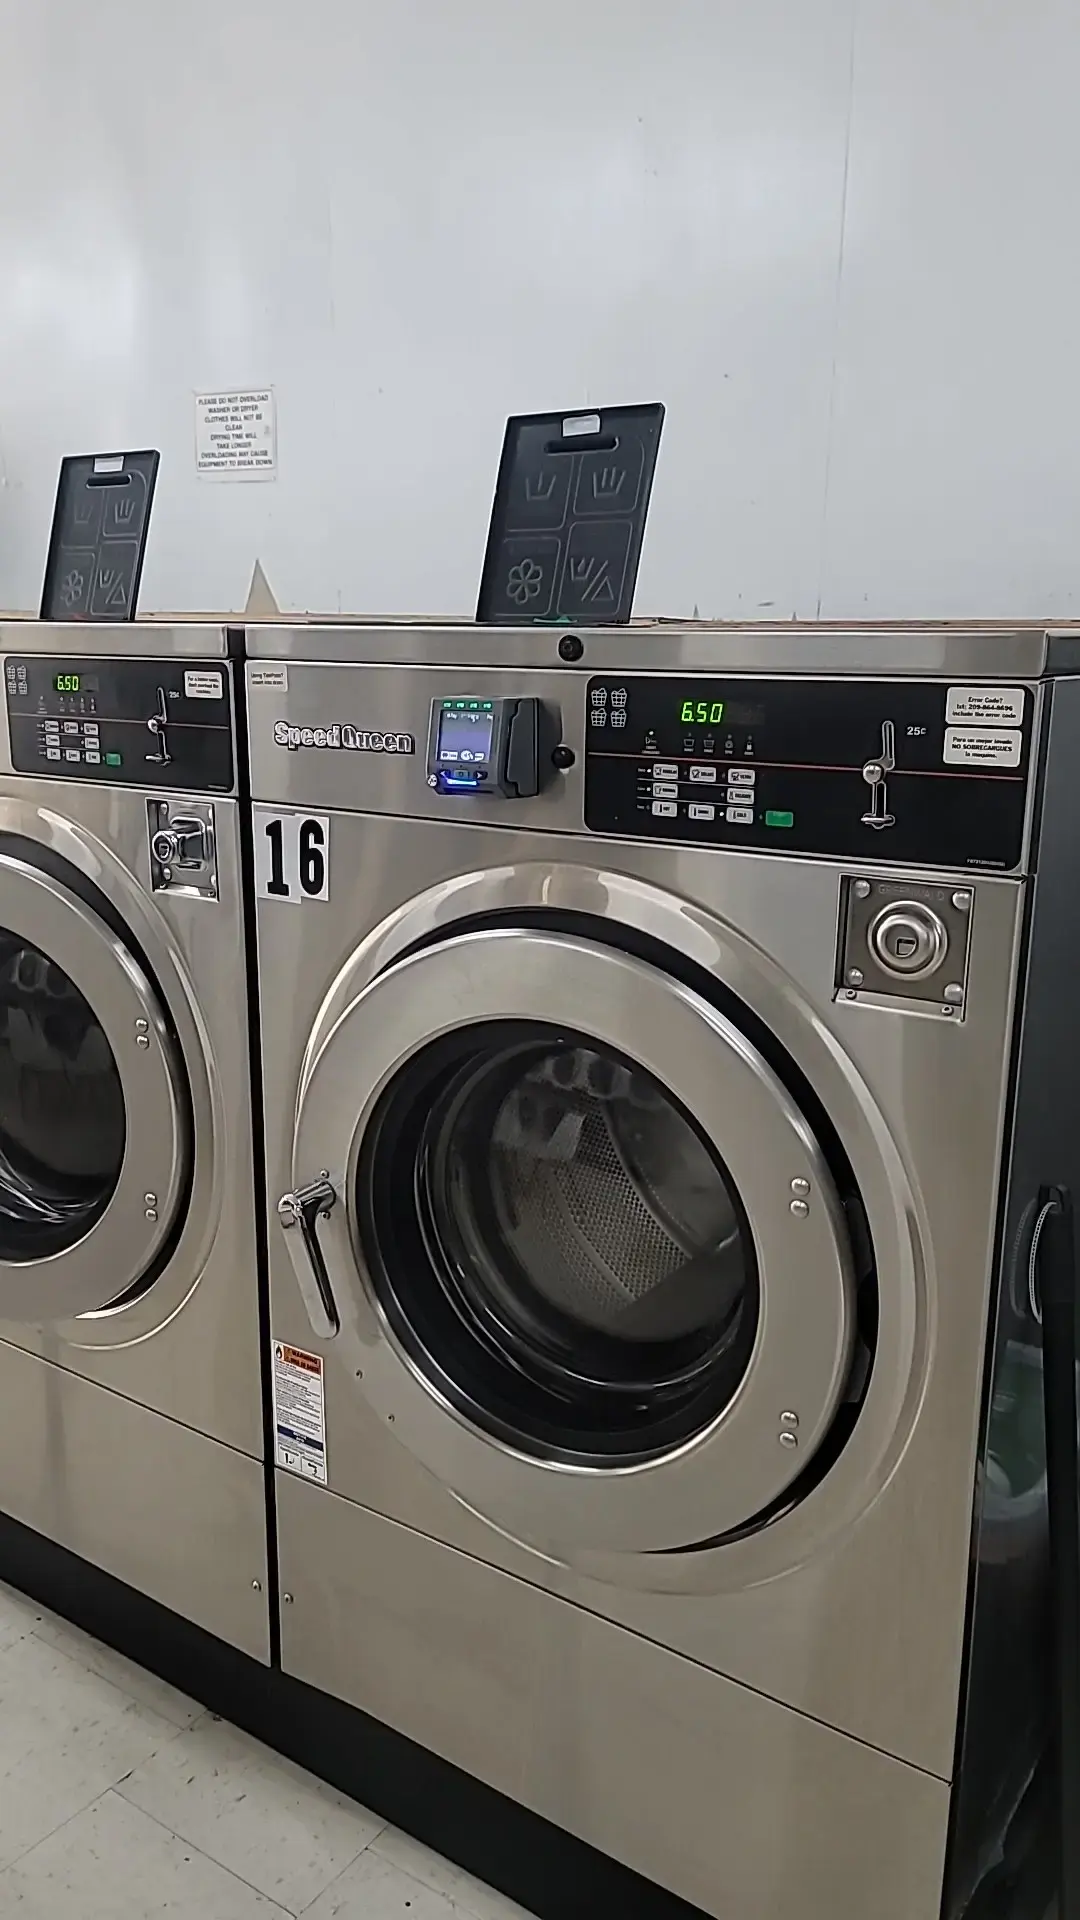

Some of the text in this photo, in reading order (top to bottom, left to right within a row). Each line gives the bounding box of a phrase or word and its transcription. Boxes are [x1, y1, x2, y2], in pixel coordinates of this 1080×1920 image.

[228, 396, 238, 404] NOT
[240, 394, 268, 403] OVERLOAD
[241, 404, 258, 412] DRYER
[204, 415, 228, 423] CLOTHES
[201, 451, 237, 459] OVERLOADING
[57, 675, 79, 691] 6.50
[984, 696, 1003, 704] Code?
[681, 702, 723, 723] 6.50
[274, 721, 415, 755] Speed Queen
[963, 744, 1013, 752] SOBRECARGUES
[265, 819, 324, 896] 16
